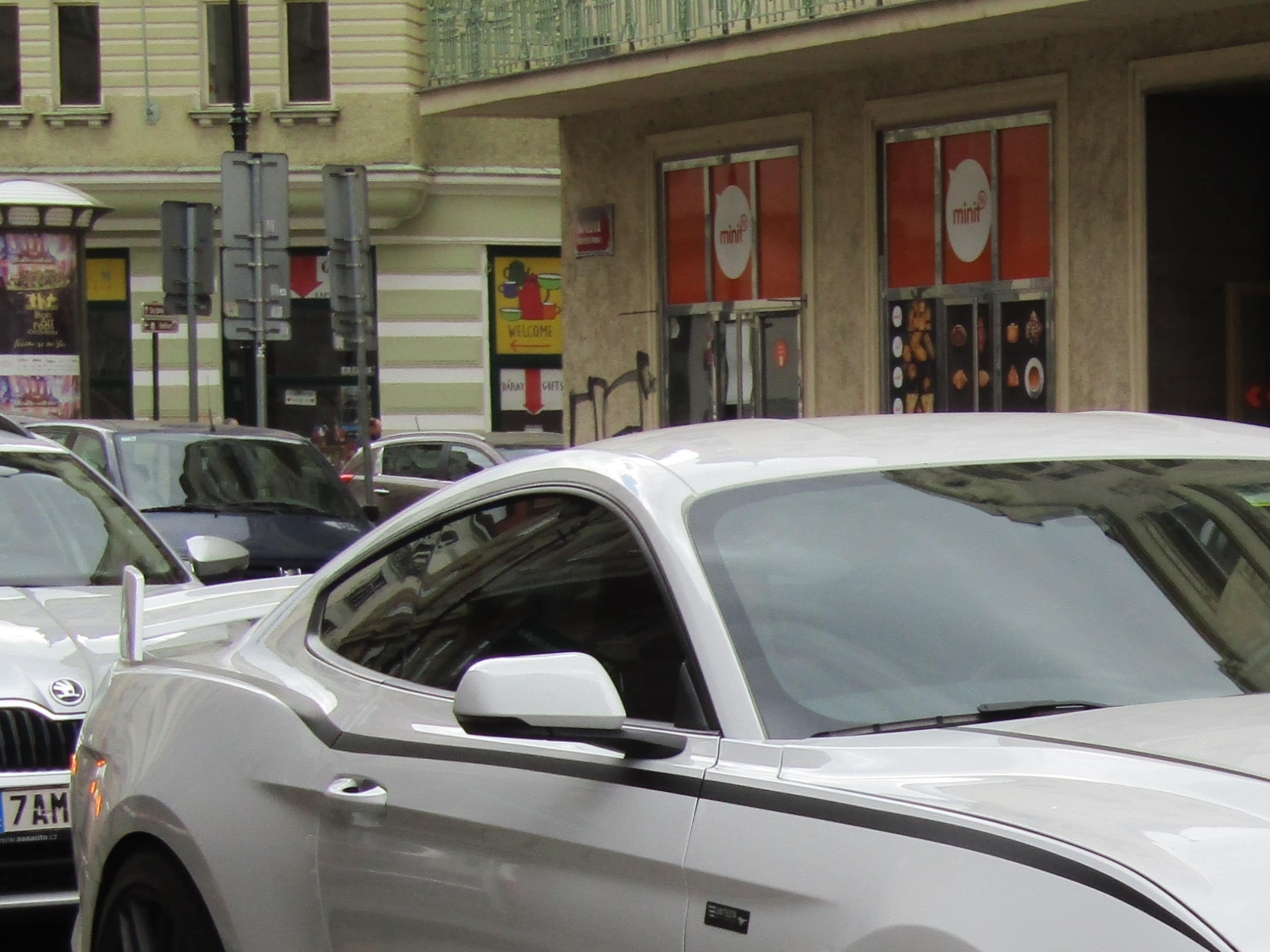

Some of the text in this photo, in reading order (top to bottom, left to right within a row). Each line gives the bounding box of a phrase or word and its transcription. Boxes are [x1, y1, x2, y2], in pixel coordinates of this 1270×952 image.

[508, 325, 553, 338] WELCOME
[502, 379, 525, 392] DÁRKY
[543, 381, 564, 391] GIFTS
[10, 792, 70, 826] 7AM
